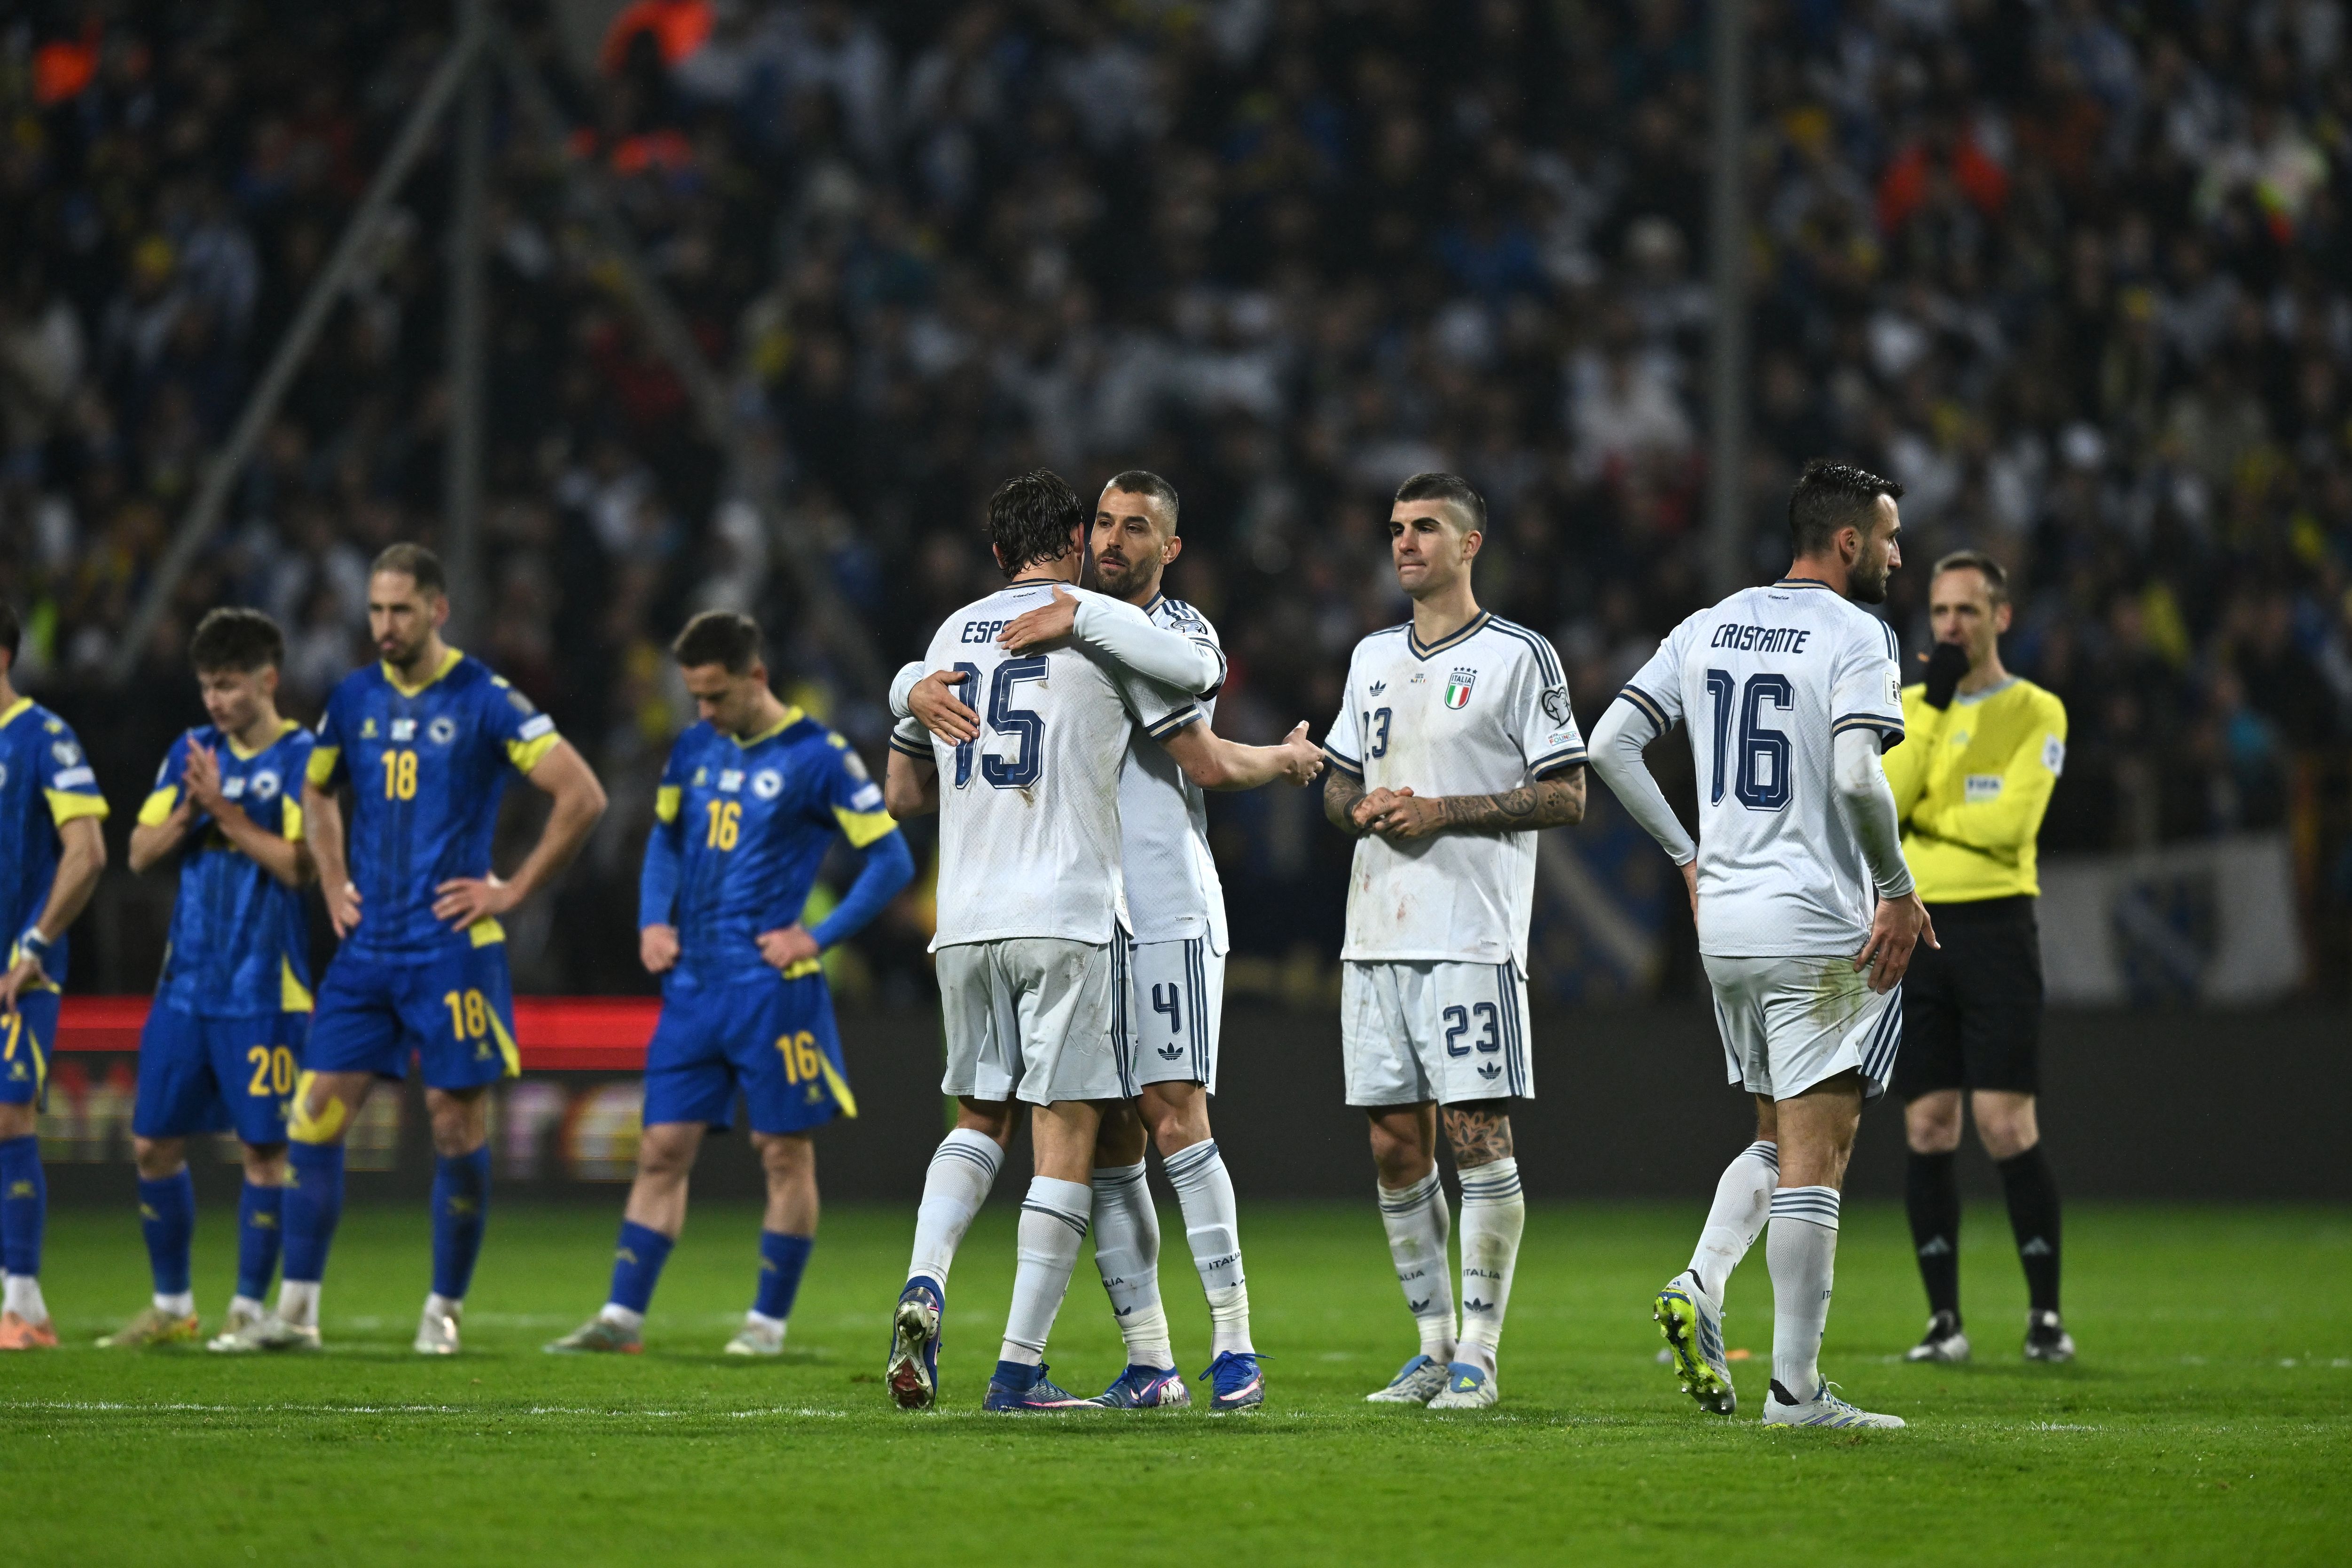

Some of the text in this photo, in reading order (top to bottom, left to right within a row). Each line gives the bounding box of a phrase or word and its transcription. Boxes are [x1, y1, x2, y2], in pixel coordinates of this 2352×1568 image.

[1711, 623, 1811, 654] CRISTANTE
[1451, 675, 1472, 684] ITALIA
[953, 655, 1050, 790] 15
[1707, 668, 1795, 812] 16
[381, 749, 418, 800] 18
[706, 799, 742, 851] 16
[443, 988, 486, 1041] 18
[1152, 982, 1182, 1035] 4
[1442, 1002, 1502, 1058] 23
[247, 1045, 293, 1096] 20
[776, 1031, 819, 1086] 16
[1208, 1251, 1240, 1270] ITALIA
[1463, 1269, 1501, 1280] ITALIA
